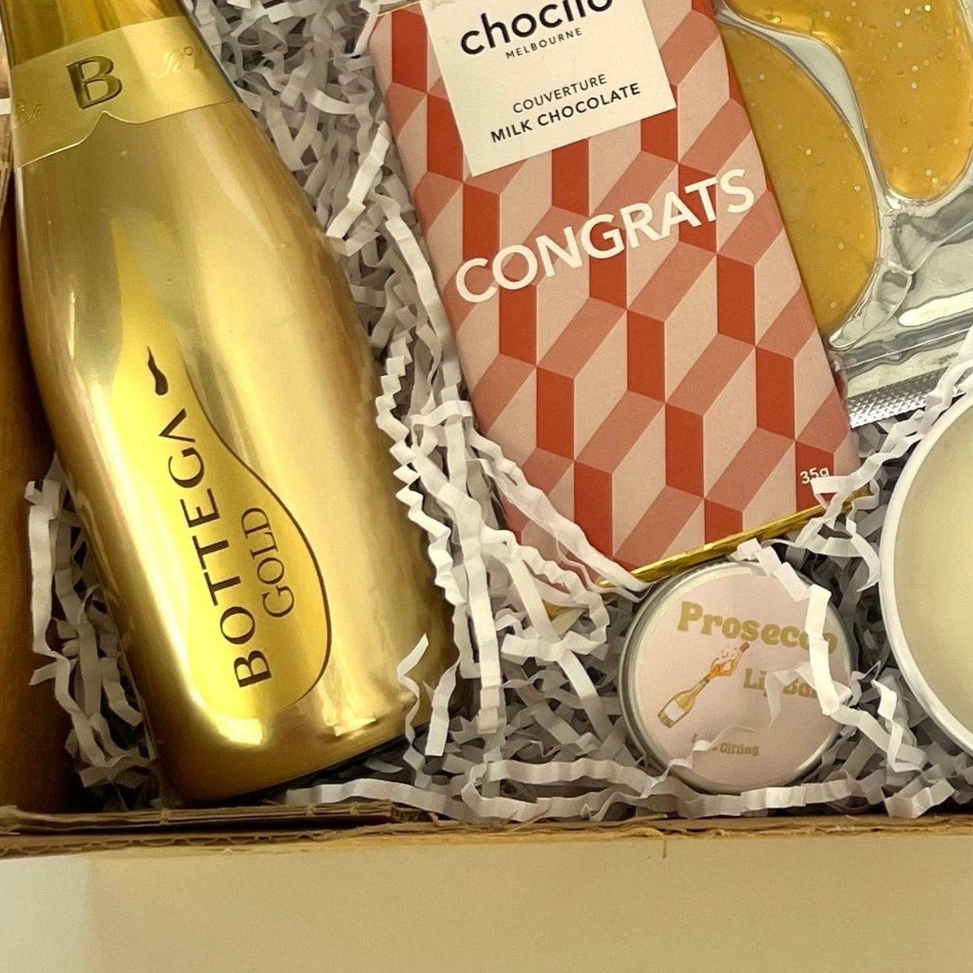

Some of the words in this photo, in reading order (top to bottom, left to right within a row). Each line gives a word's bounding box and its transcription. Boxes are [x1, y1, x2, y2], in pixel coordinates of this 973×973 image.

[505, 28, 583, 60] MELBOURNE
[66, 55, 123, 110] B
[512, 73, 607, 114] COUVERTURE
[490, 119, 533, 143] MILK
[536, 82, 642, 127] CHOCOLATE
[455, 169, 756, 303] CONGRATS
[158, 408, 272, 688] BOTTEGA
[240, 506, 295, 618] GOLD
[743, 667, 768, 697] Li
